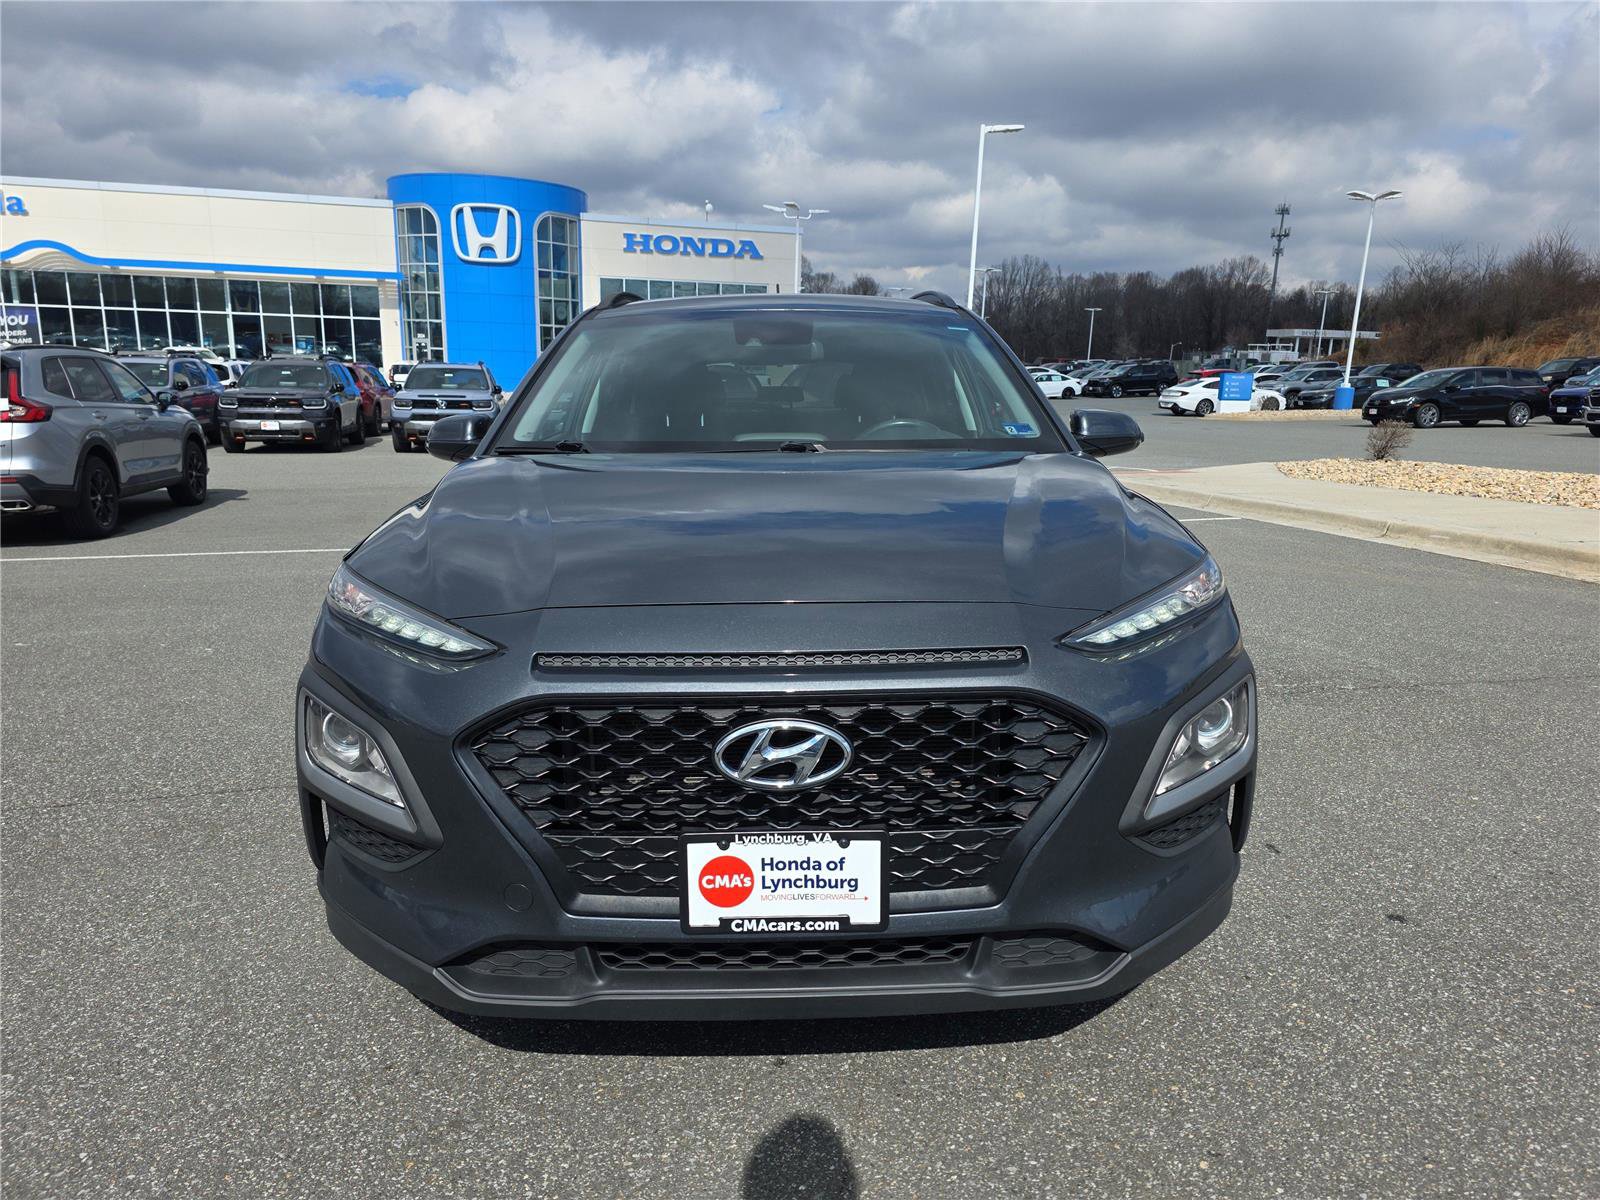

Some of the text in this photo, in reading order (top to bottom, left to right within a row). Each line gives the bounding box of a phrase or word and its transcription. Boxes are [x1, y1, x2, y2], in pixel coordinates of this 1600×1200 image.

[623, 233, 764, 260] HONDA
[735, 833, 833, 846] Lynchburg, VA
[761, 856, 846, 871] Honda of
[701, 874, 752, 889] CMA's
[761, 874, 859, 893] Lynchburg
[731, 919, 840, 932] CMAcars.com
